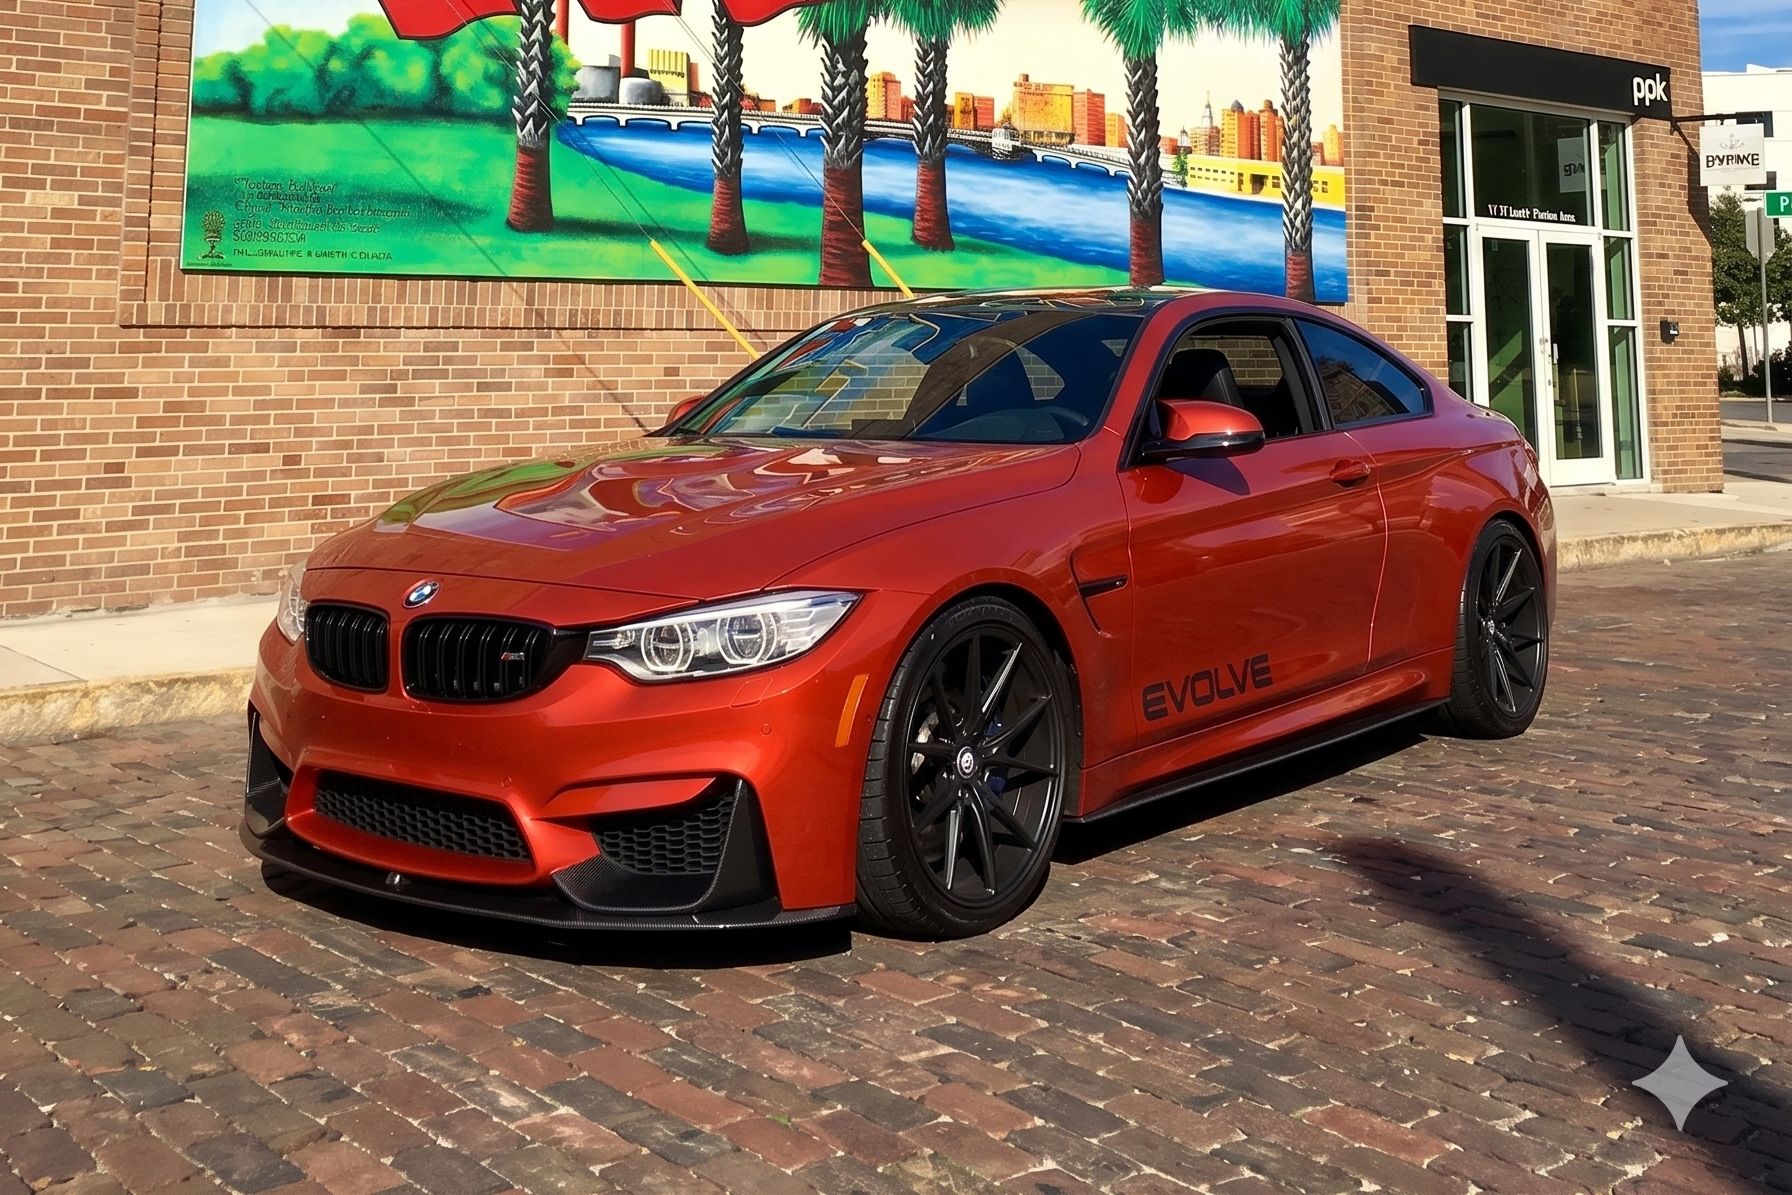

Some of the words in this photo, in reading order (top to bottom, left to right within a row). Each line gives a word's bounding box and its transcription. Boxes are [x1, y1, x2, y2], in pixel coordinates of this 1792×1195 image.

[1632, 73, 1668, 107] ppk
[1779, 195, 1792, 213] P
[1142, 653, 1273, 721] EVOLVE
